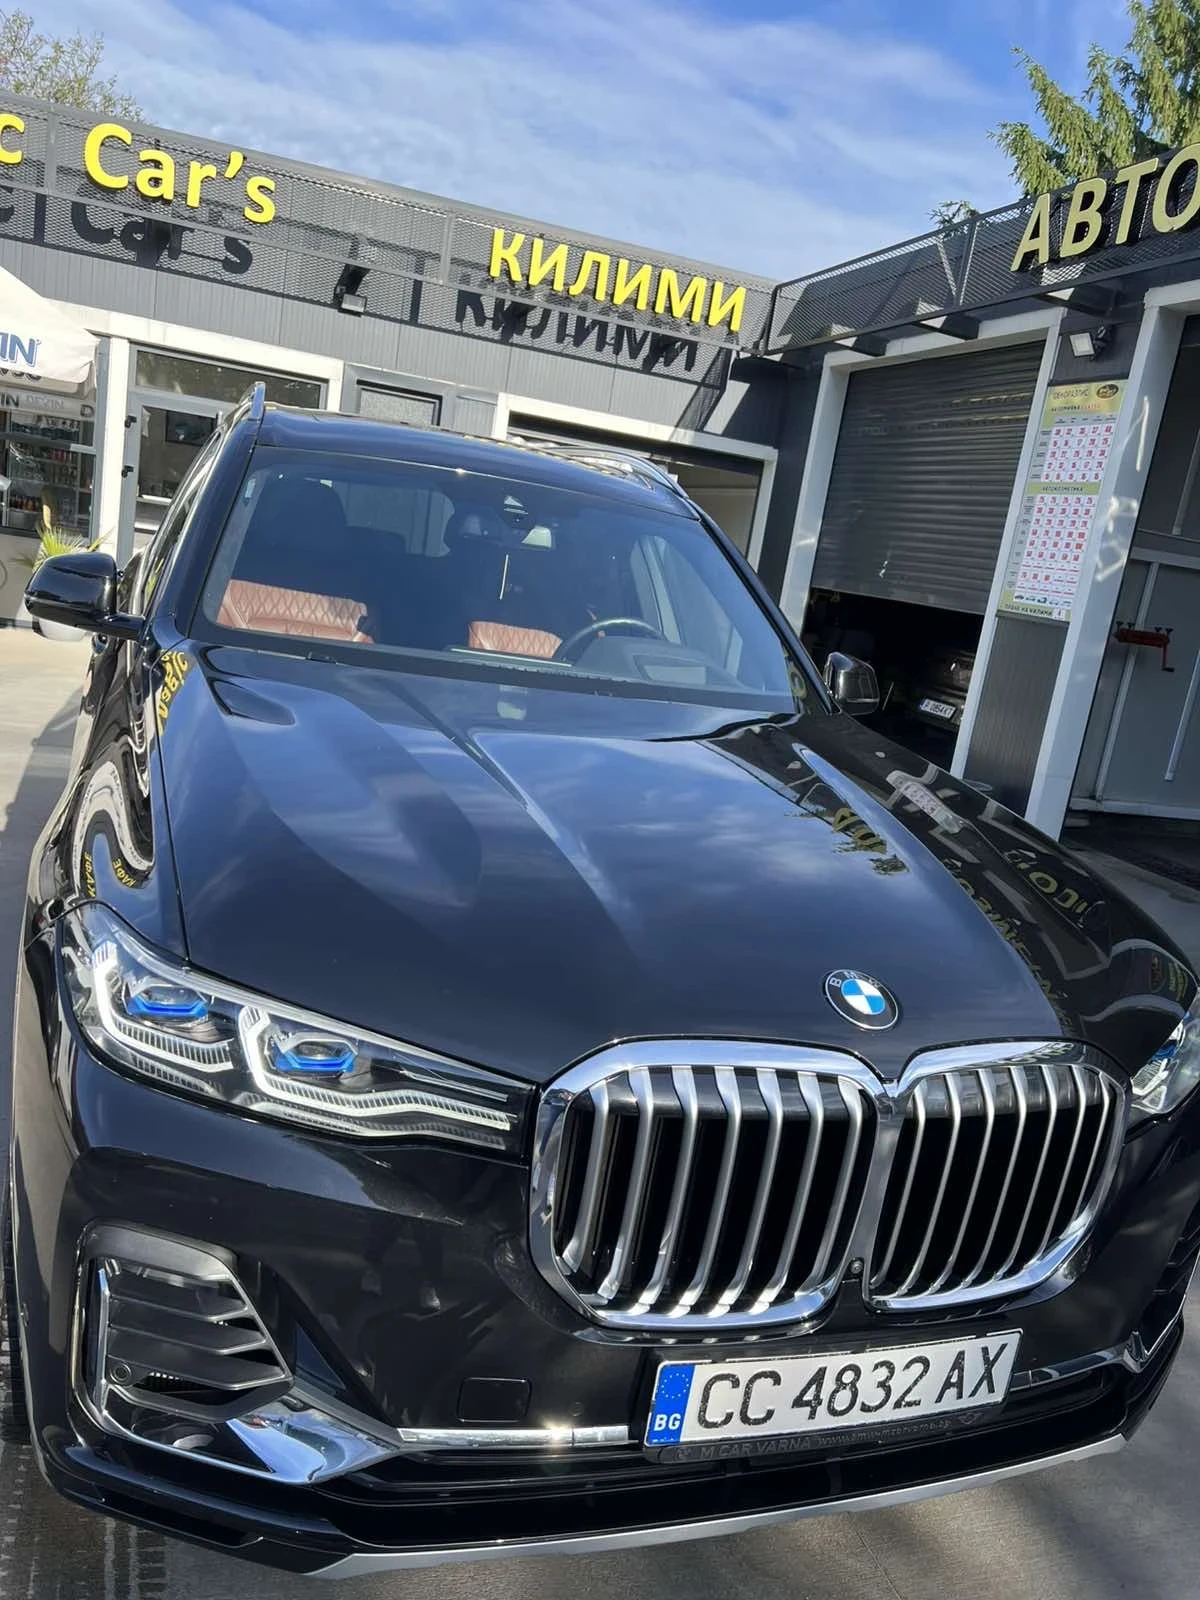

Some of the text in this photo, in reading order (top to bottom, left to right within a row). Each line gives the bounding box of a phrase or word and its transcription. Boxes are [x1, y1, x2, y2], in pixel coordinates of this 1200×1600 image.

[489, 228, 747, 332] КИЛИМИ
[697, 1343, 1009, 1429] CC 4832 AX
[653, 1413, 682, 1432] BG
[718, 1442, 752, 1457] CAR
[755, 1438, 810, 1455] VARNA
